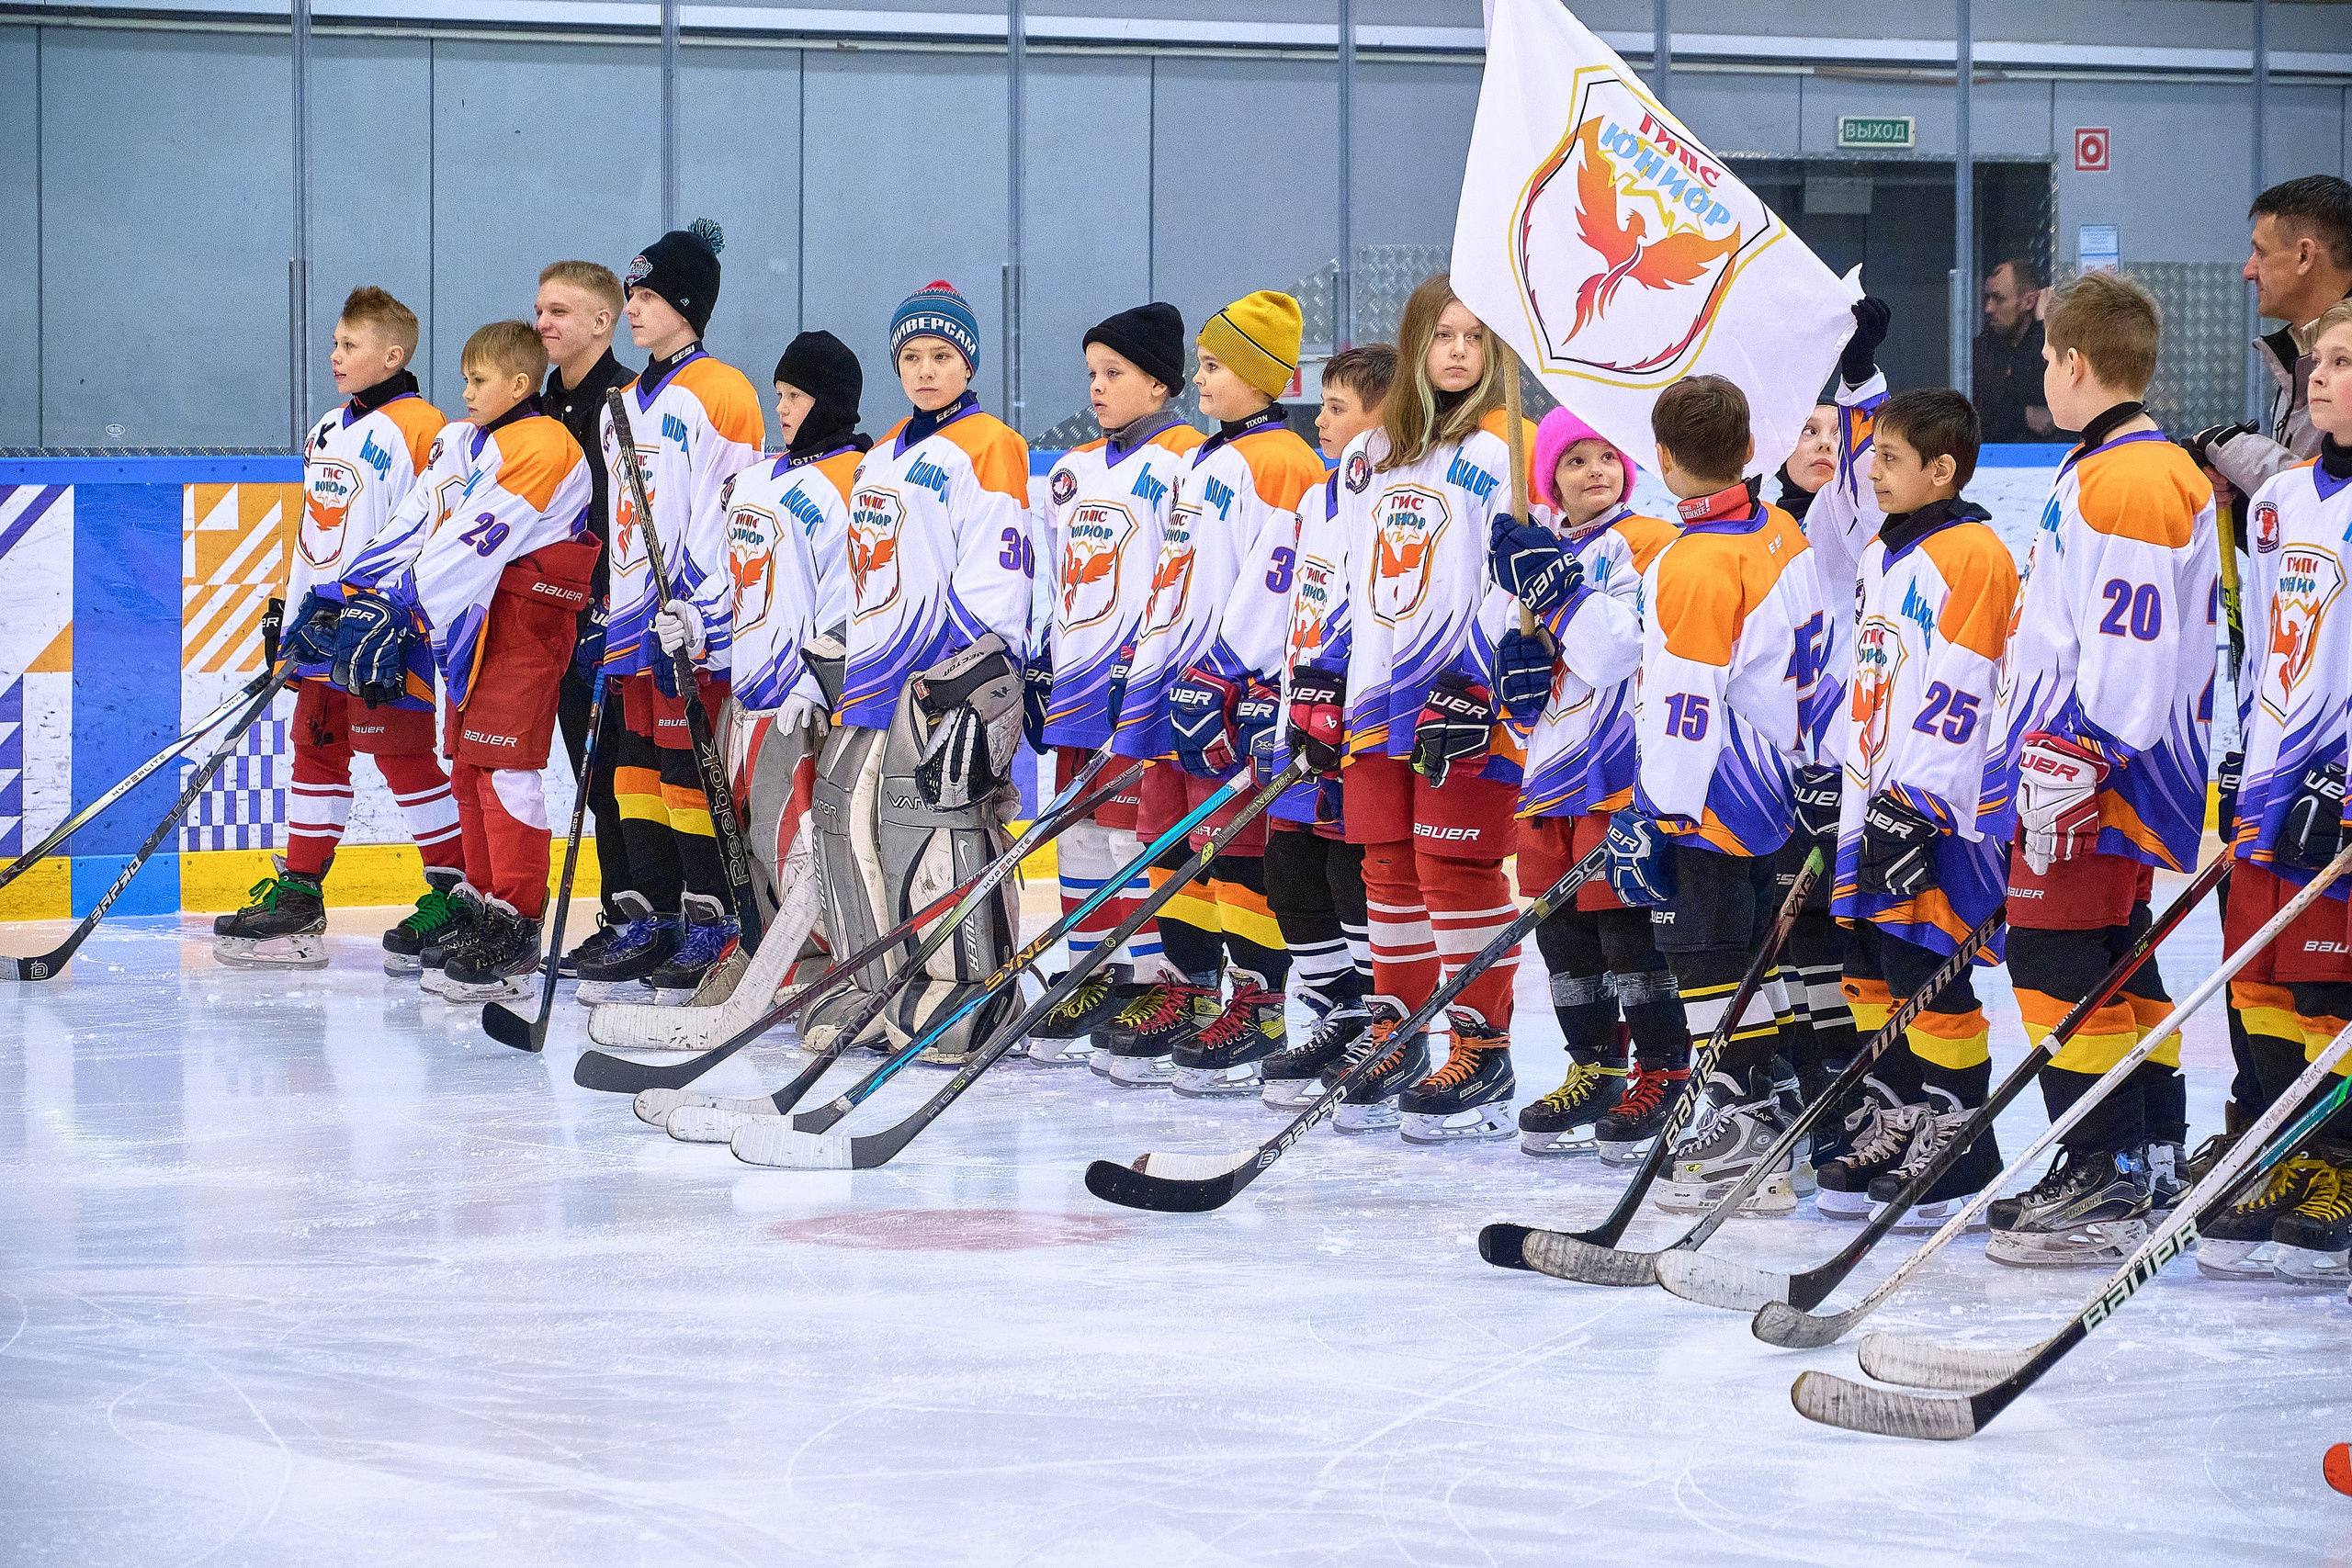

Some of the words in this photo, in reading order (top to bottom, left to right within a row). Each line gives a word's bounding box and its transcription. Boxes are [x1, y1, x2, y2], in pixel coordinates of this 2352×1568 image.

[1845, 123, 1905, 140] ВЫХОД
[1639, 112, 1721, 187] ГИПС
[1600, 122, 1731, 226] ЮНИОР
[1245, 414, 1269, 429] TIXON
[903, 451, 950, 503] KNAUF
[1445, 446, 1500, 507] KNAUF
[1204, 474, 1236, 522] NAUF
[1079, 510, 1108, 524] ГИПС
[458, 513, 511, 558] 29
[999, 527, 1035, 580] 30
[531, 581, 583, 603] BAUER
[1521, 552, 1578, 610] AUER
[2279, 576, 2316, 593] ЮНИО
[340, 608, 377, 622] UER
[2099, 578, 2162, 642] 20
[1170, 688, 1213, 705] UER
[1288, 687, 1336, 704] UER
[1912, 680, 1982, 745] 25
[658, 718, 687, 728] BAUE
[1664, 692, 1710, 742] 15
[463, 728, 518, 748] BAUER
[2022, 752, 2081, 783] UER
[1262, 773, 1293, 801] BAUER
[700, 737, 751, 887] Reebok
[1864, 805, 1914, 840] UER
[1413, 823, 1481, 841] BAUER
[984, 930, 1054, 992] SYNC
[2133, 940, 2150, 958] LITE
[2303, 940, 2350, 954] BAU
[1871, 918, 1996, 1063] WARRIOR
[2082, 1217, 2202, 1335] BAUER
